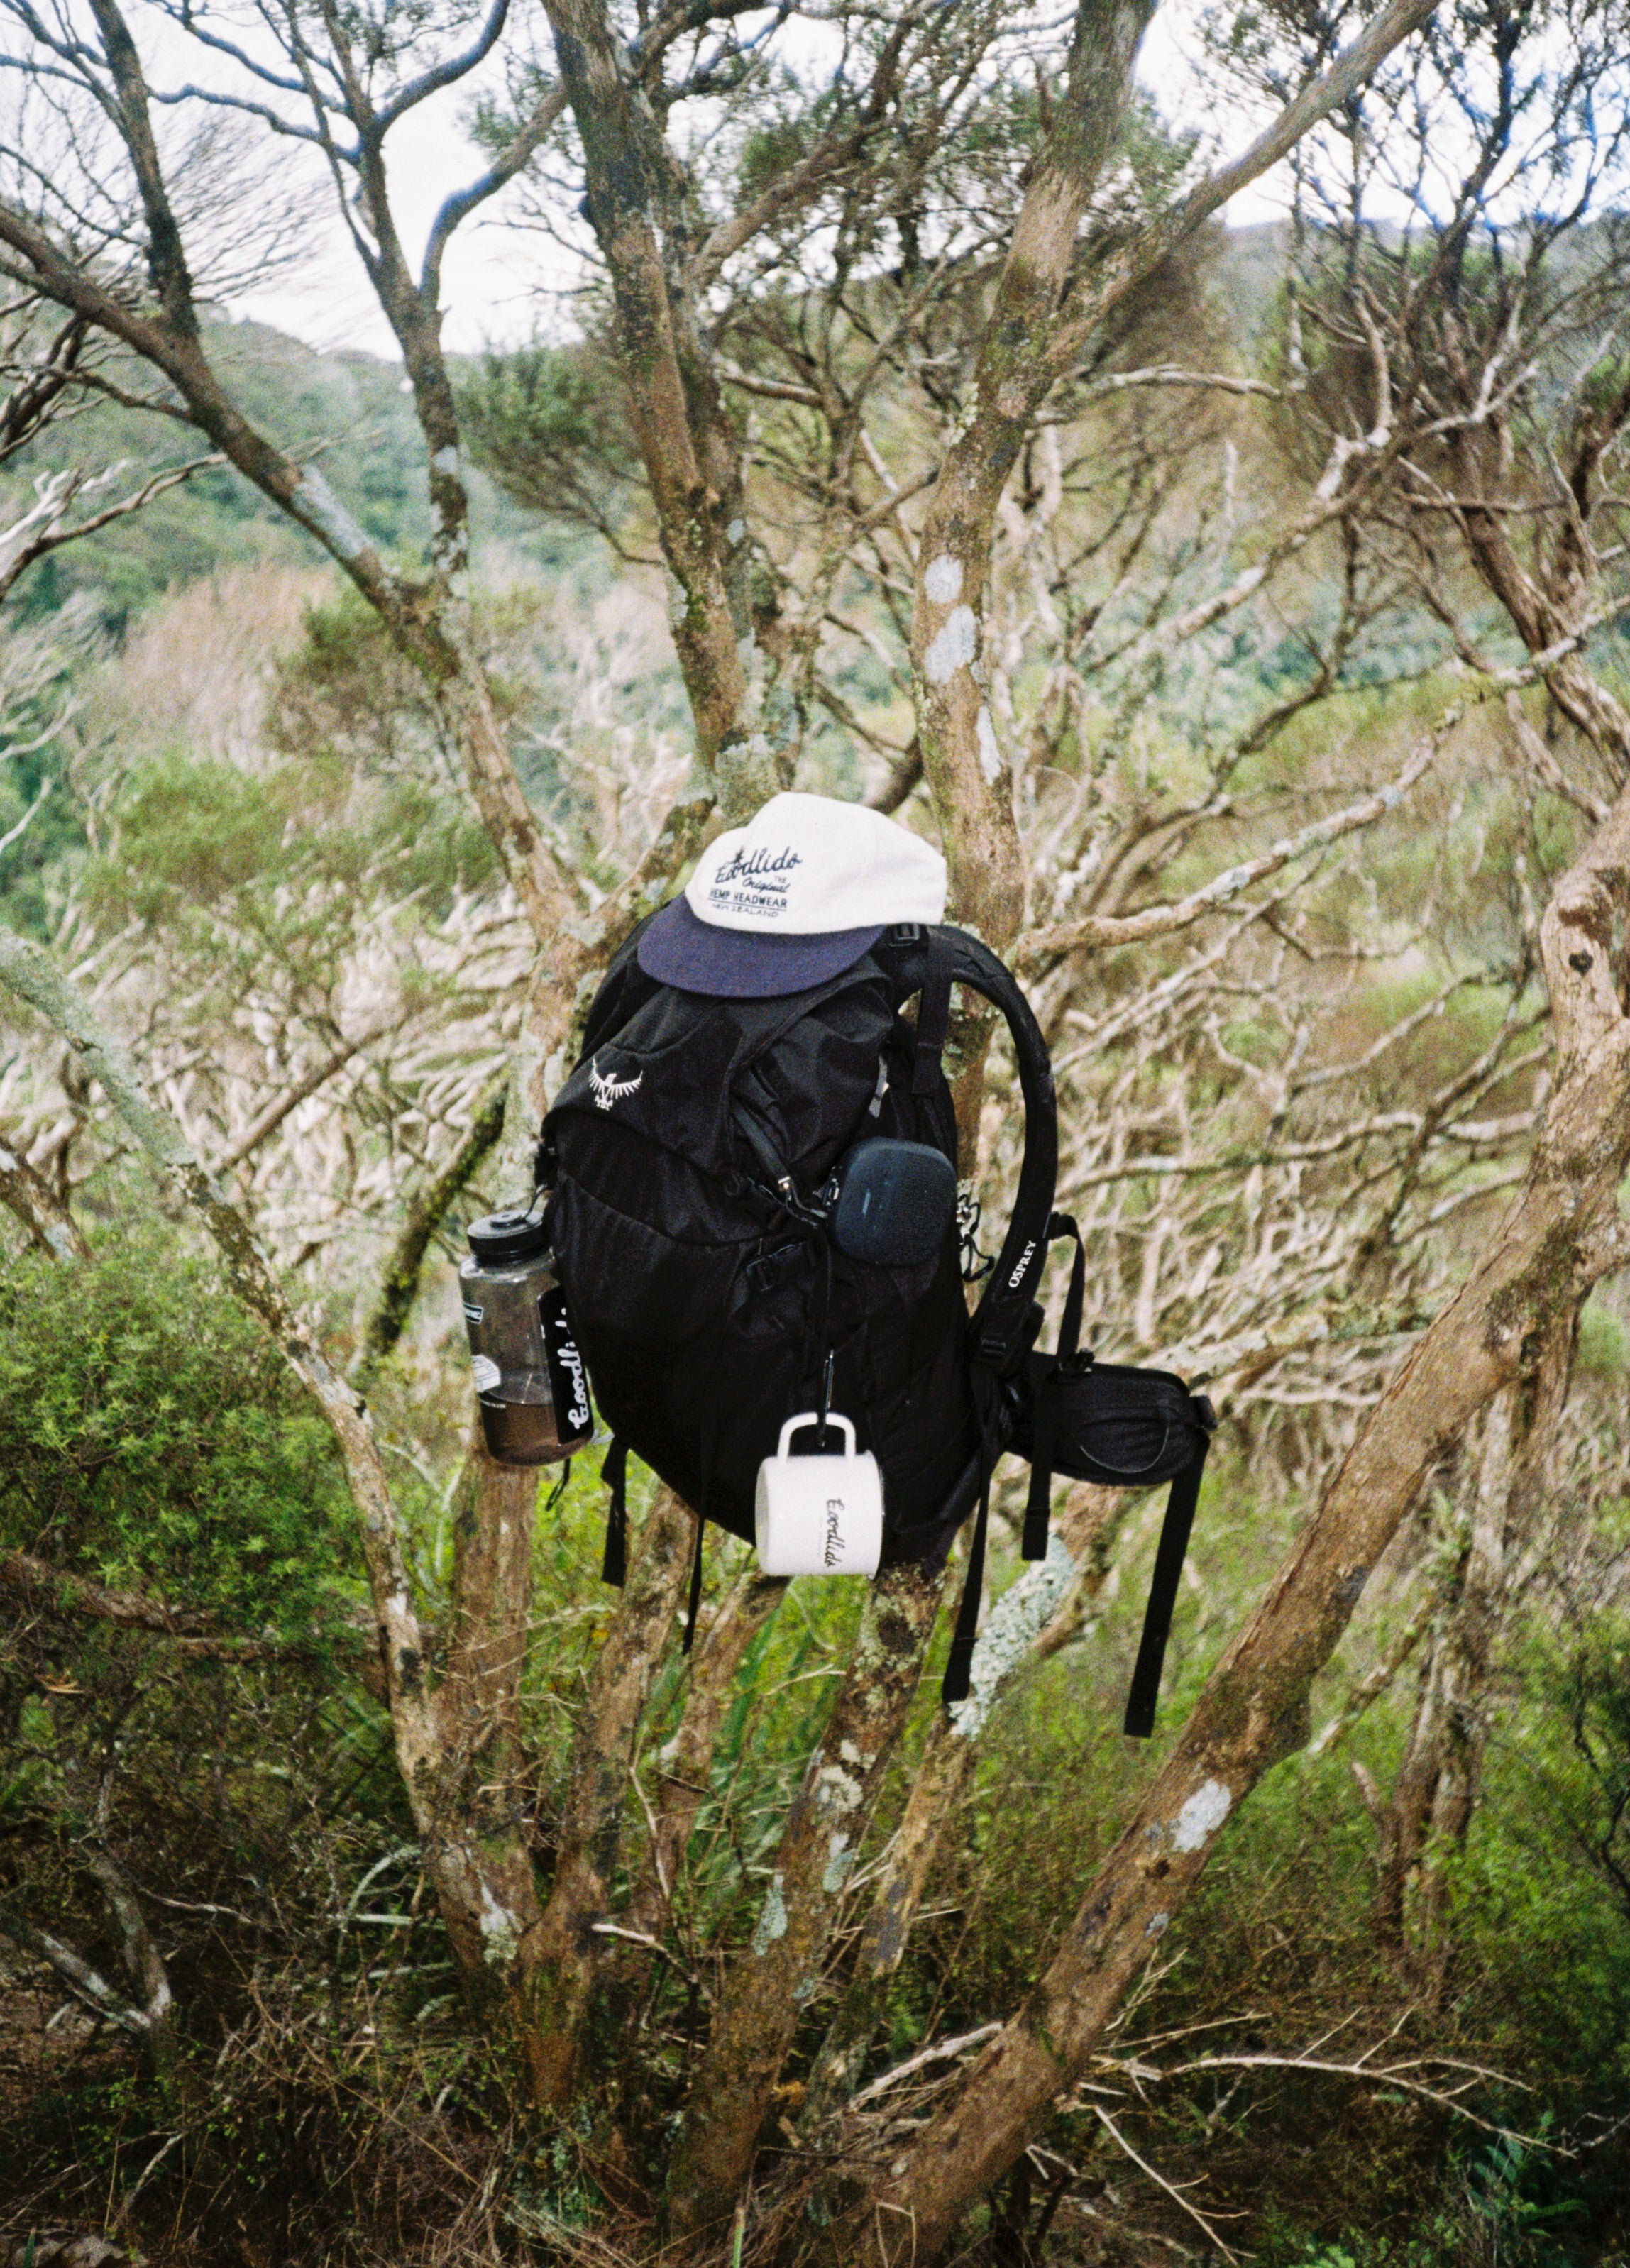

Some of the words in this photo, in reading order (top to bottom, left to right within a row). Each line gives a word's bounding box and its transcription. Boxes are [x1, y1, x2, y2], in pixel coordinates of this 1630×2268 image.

[742, 876, 791, 893] Original
[774, 875, 787, 883] THE
[710, 888, 730, 900] HEMP
[734, 891, 788, 908] HEADWEAR
[732, 905, 779, 918] ZEALAND
[1008, 1240, 1036, 1288] OSPREY
[554, 1307, 589, 1429] Goodli
